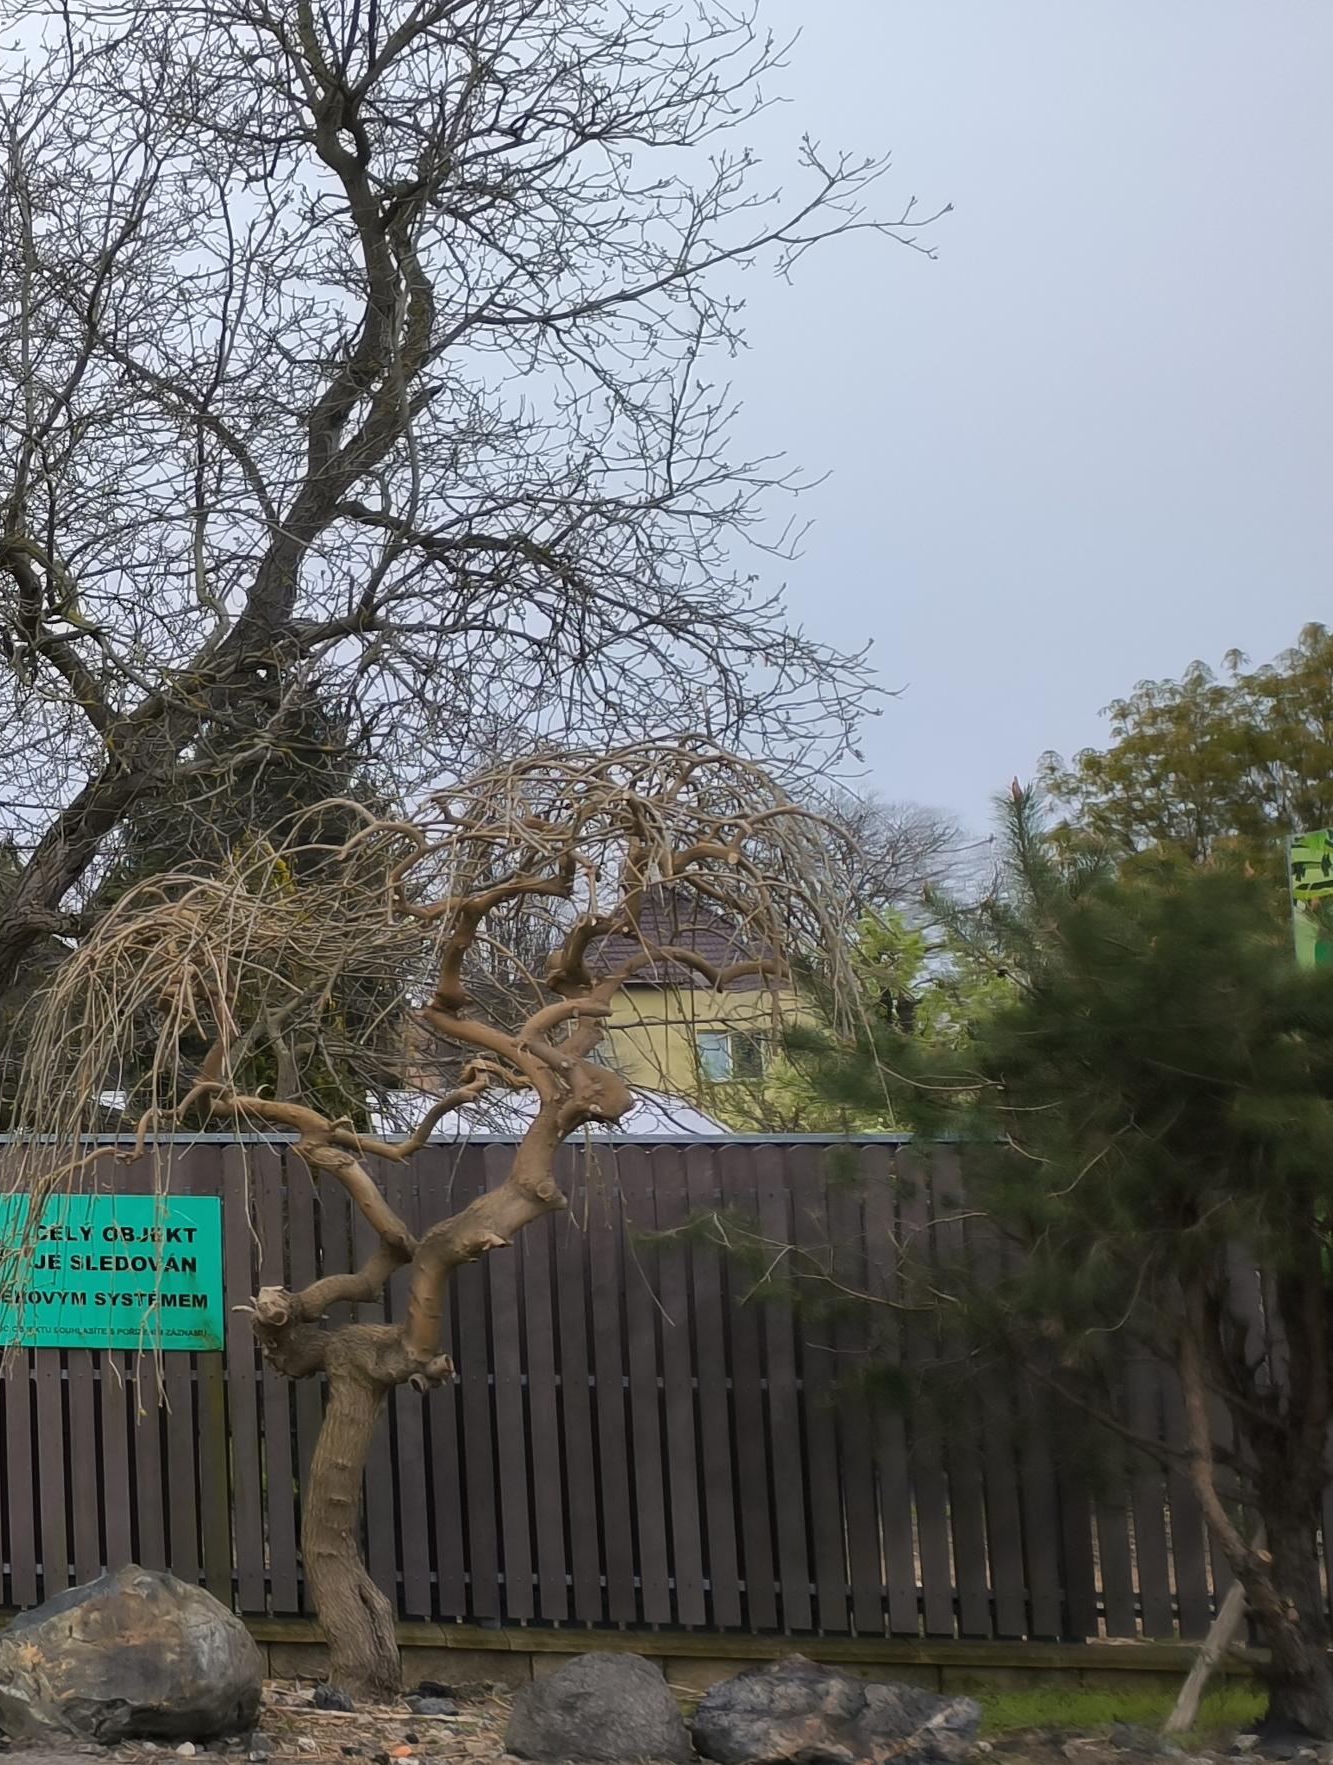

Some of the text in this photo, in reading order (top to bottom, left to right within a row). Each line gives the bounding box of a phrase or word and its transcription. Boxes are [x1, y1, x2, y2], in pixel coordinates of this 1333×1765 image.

[36, 1222, 197, 1243] CELÝ OBJEKT
[34, 1252, 197, 1272] JE SLEDOVÁN
[95, 1288, 208, 1309] SYSTÉMEM
